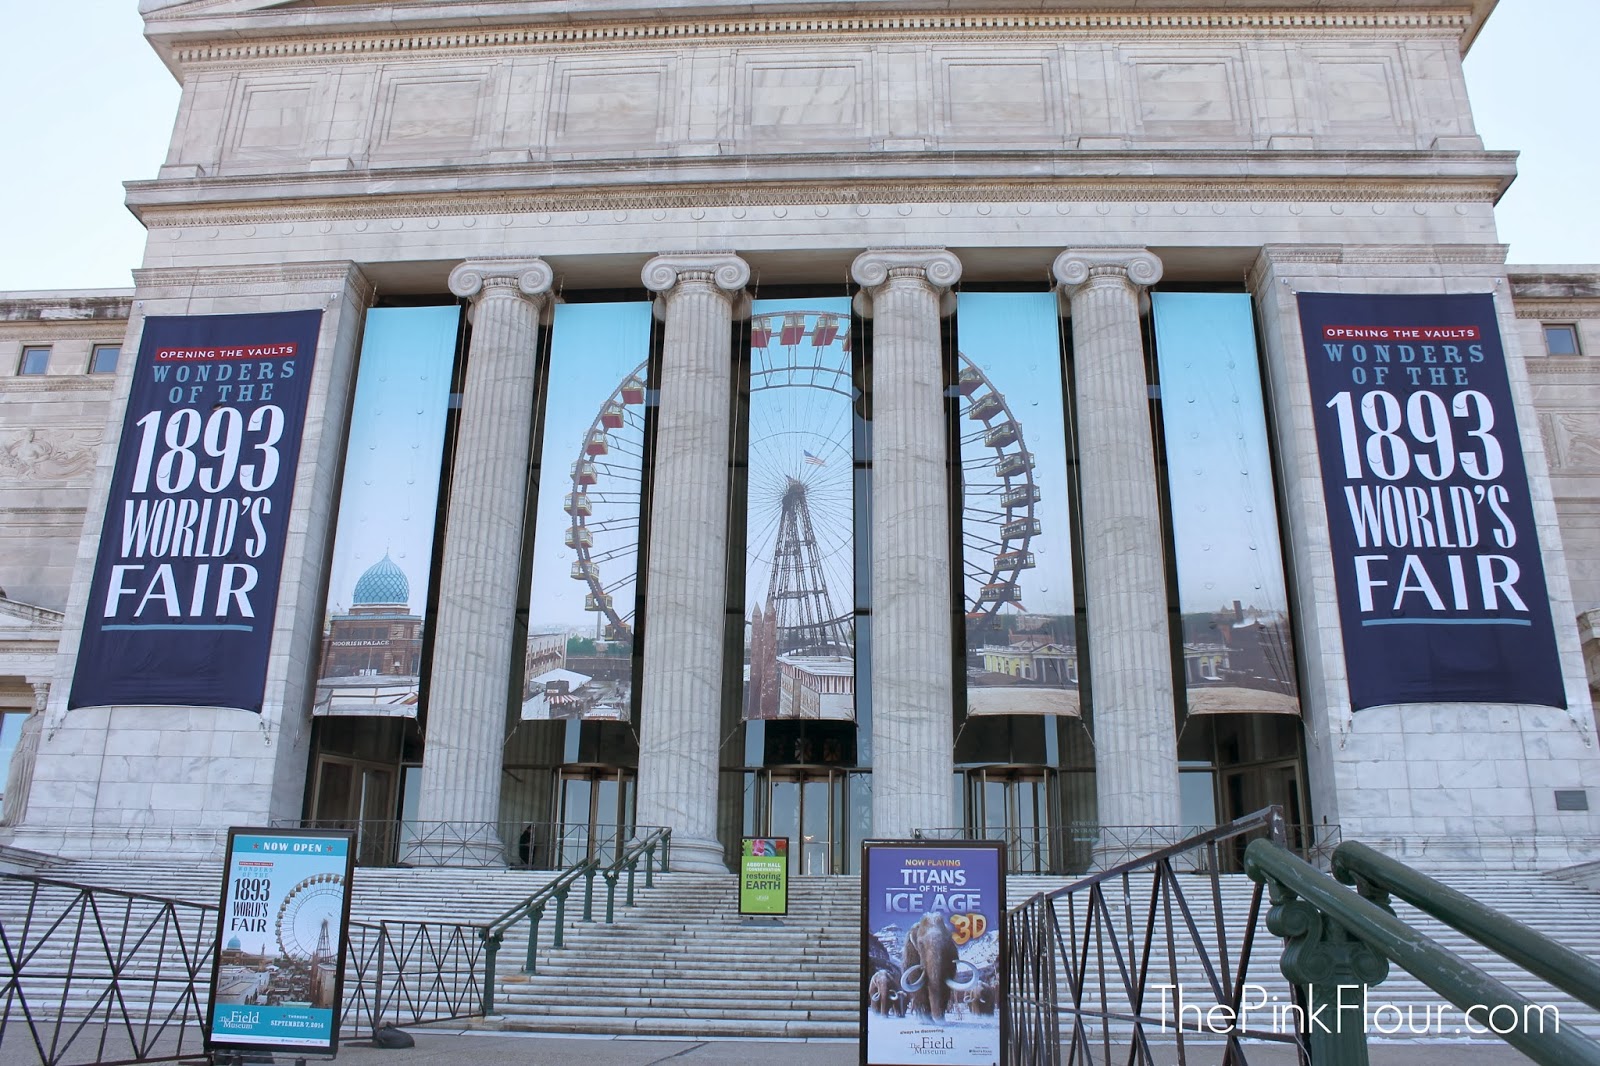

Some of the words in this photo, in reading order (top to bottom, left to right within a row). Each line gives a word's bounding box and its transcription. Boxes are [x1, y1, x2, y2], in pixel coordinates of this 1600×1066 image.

[1326, 328, 1389, 338] OPENING
[1424, 330, 1475, 338] VAULTS
[160, 350, 215, 358] OPENING
[248, 346, 294, 356] VAULTS
[1323, 344, 1484, 362] WONDERS
[152, 361, 295, 382] WONDERS
[1352, 366, 1389, 385] OF
[1406, 367, 1469, 386] THE
[168, 386, 203, 404] OF
[218, 383, 274, 402] THE
[1325, 390, 1504, 481] 1893
[132, 404, 285, 494] 1893
[1344, 484, 1518, 548] WORLD'S
[120, 496, 272, 558] WORLD'S
[104, 562, 259, 618] FAIR
[1354, 554, 1529, 612] FAIR
[264, 842, 288, 851] NOW
[294, 844, 322, 852] OPEN
[746, 872, 781, 881] restoring
[746, 881, 781, 890] EARTH
[900, 869, 966, 886] TITANS
[235, 878, 270, 901] 1893
[234, 902, 268, 918] WORLD'S
[885, 893, 923, 912] ICE
[930, 893, 981, 913] AGE
[231, 918, 267, 932] FAIR
[950, 913, 986, 944] 3D
[223, 1021, 253, 1029] Museum
[231, 1010, 259, 1023] Field
[922, 1037, 953, 1049] Field
